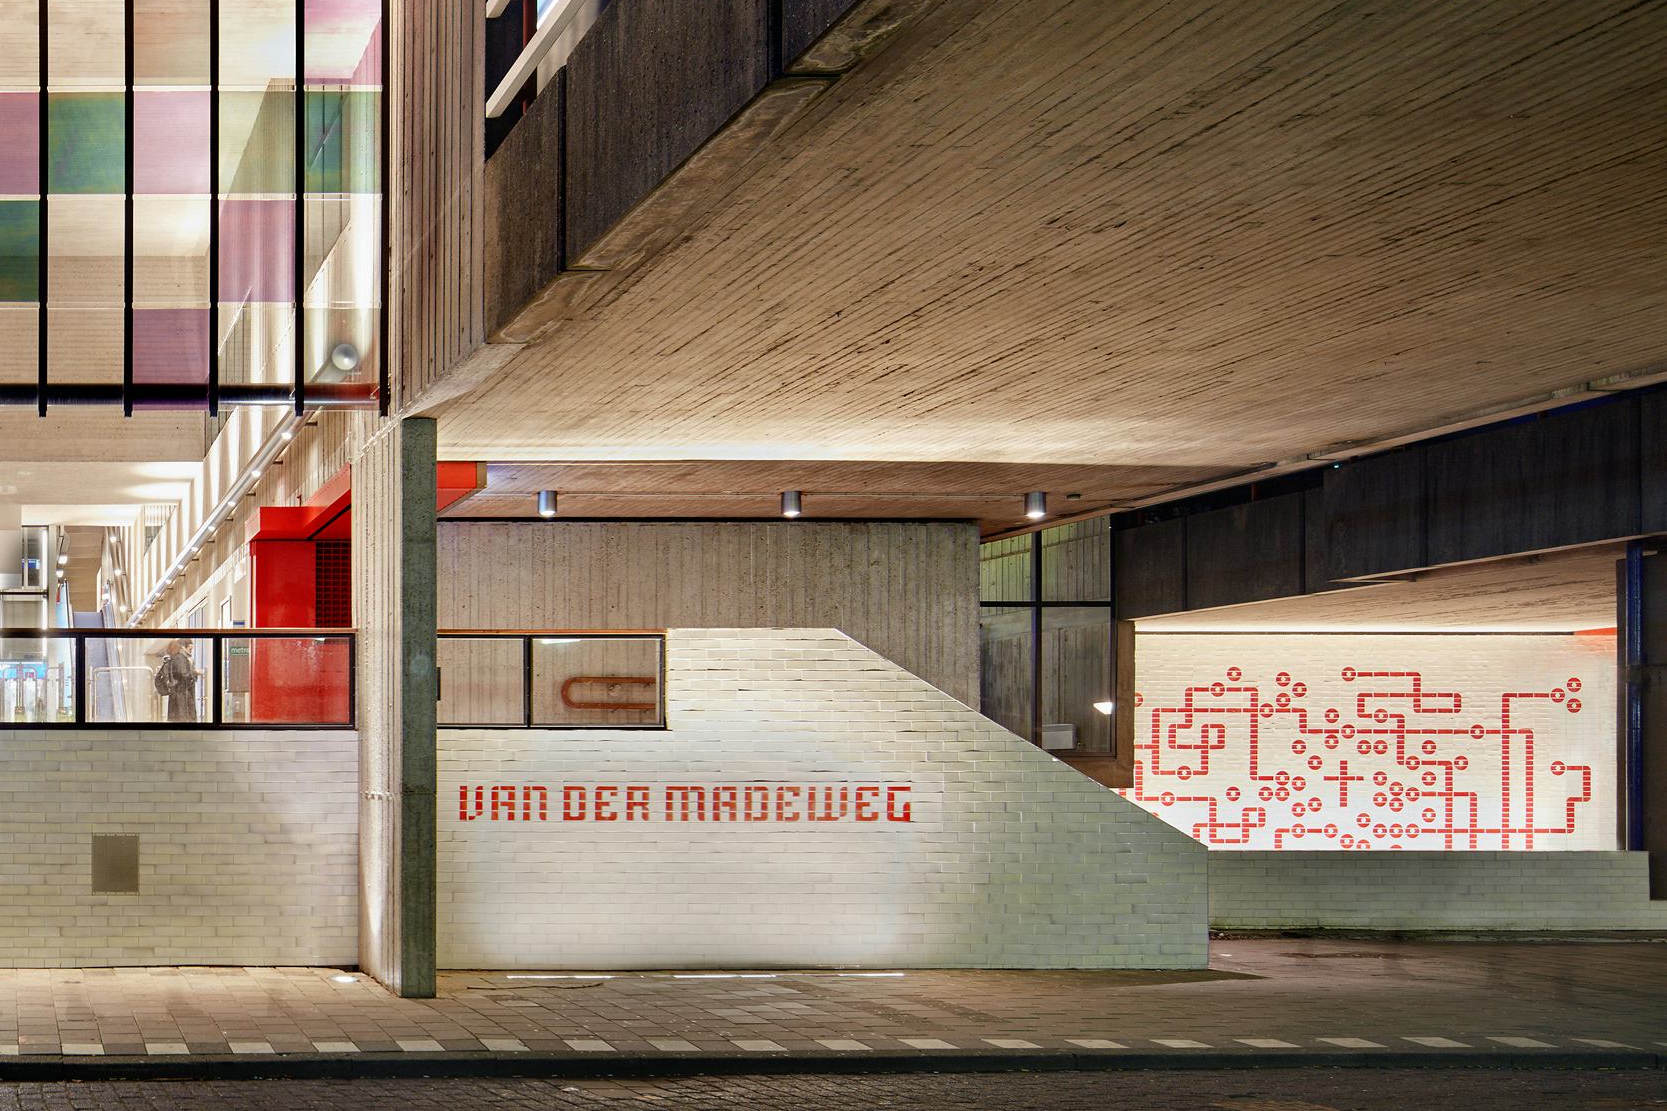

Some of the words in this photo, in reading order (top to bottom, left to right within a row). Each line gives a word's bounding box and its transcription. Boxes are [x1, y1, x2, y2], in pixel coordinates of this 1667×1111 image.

[459, 785, 548, 821] VAN
[563, 785, 650, 821] DER
[665, 785, 911, 822] MADEWEG
